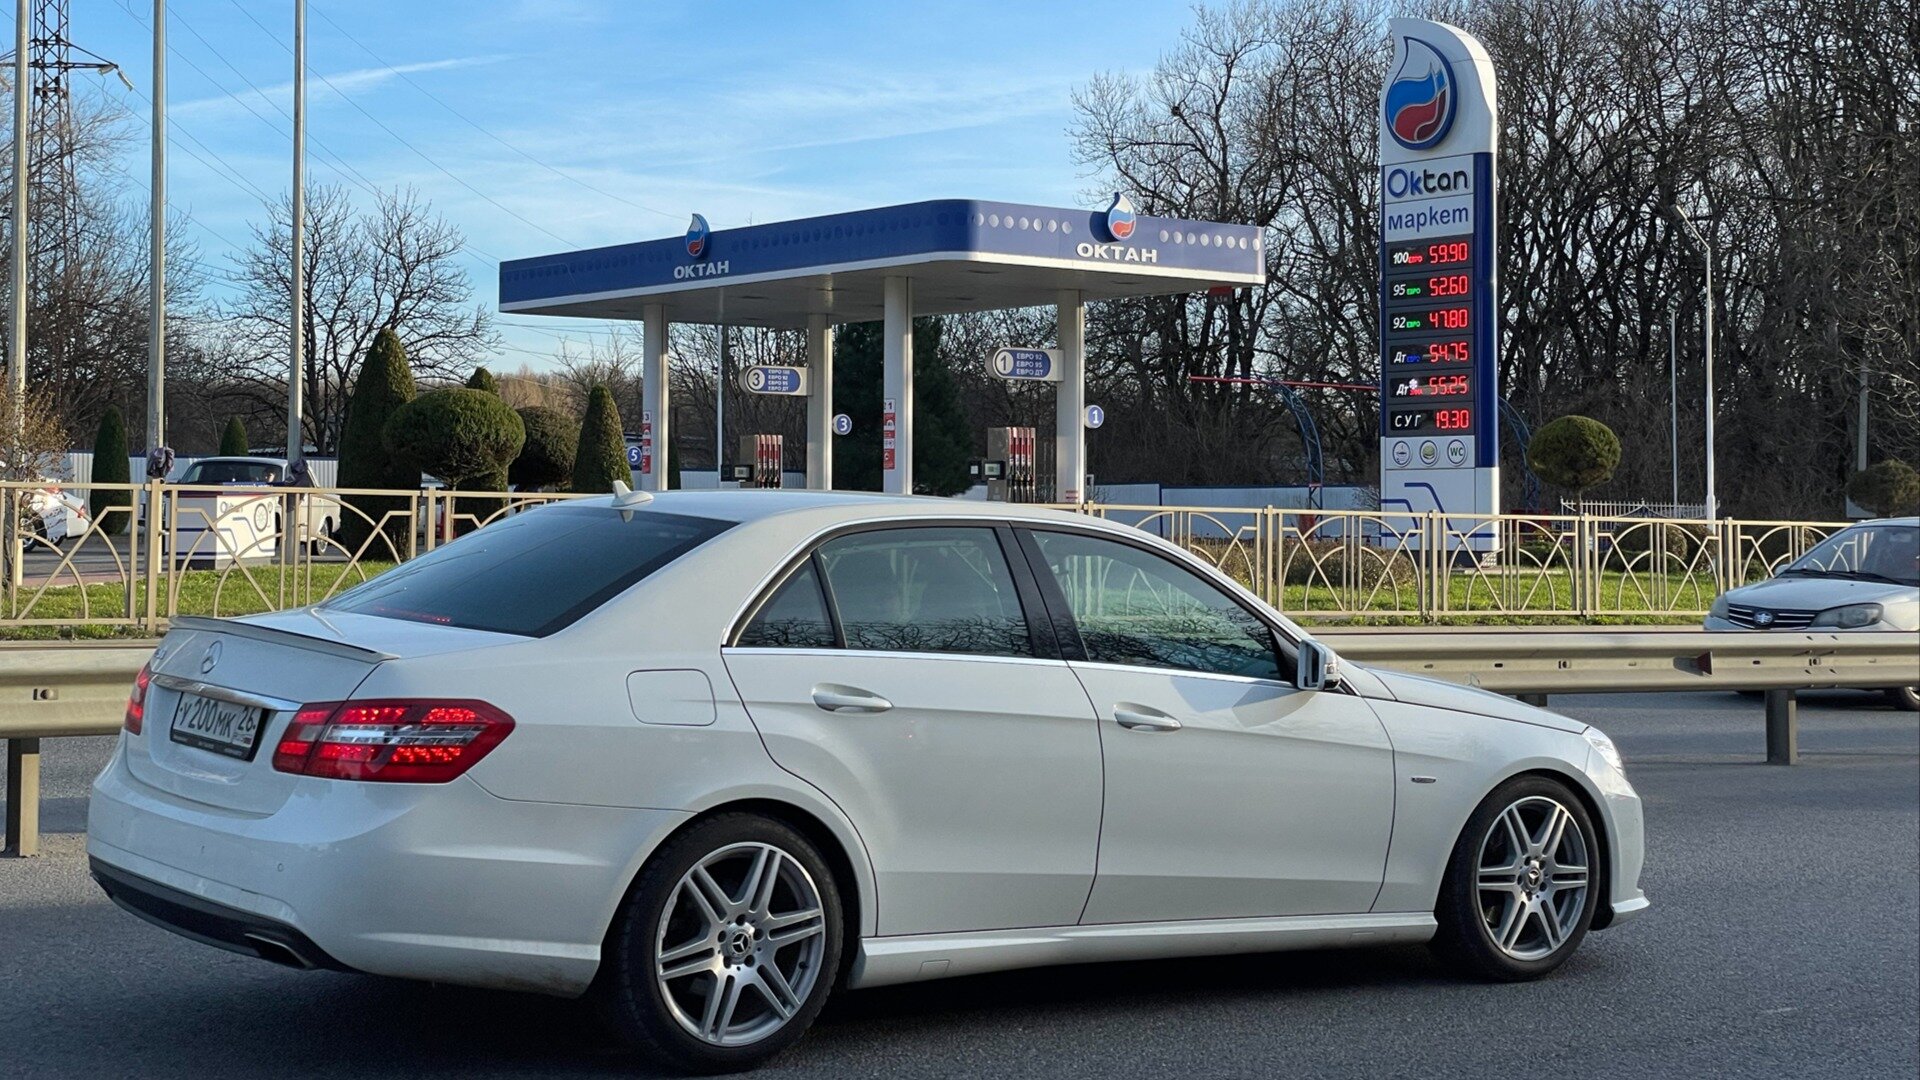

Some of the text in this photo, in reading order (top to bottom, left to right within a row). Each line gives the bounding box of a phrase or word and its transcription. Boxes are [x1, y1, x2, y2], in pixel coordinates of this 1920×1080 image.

[1387, 168, 1469, 198] Oktan
[1076, 242, 1157, 263] ОКТАН
[1393, 252, 1409, 264] 100
[1429, 243, 1468, 264] 59.90
[674, 260, 729, 279] ОКТАН
[1393, 284, 1406, 296] 95
[1429, 276, 1468, 296] 52.60
[1393, 317, 1406, 329] 92
[1429, 309, 1468, 328] 47.80
[1393, 351, 1406, 363] Дт
[1429, 342, 1468, 362] 54.75
[1000, 355, 1006, 370] 1
[752, 373, 760, 386] 3
[1396, 383, 1408, 396] Дт
[1429, 376, 1468, 395] 55.25
[840, 418, 848, 432] 3
[1092, 410, 1099, 424] 1
[1436, 410, 1469, 429] 19.30
[630, 450, 638, 461] 5
[1450, 447, 1463, 457] WC
[238, 705, 254, 732] 26
